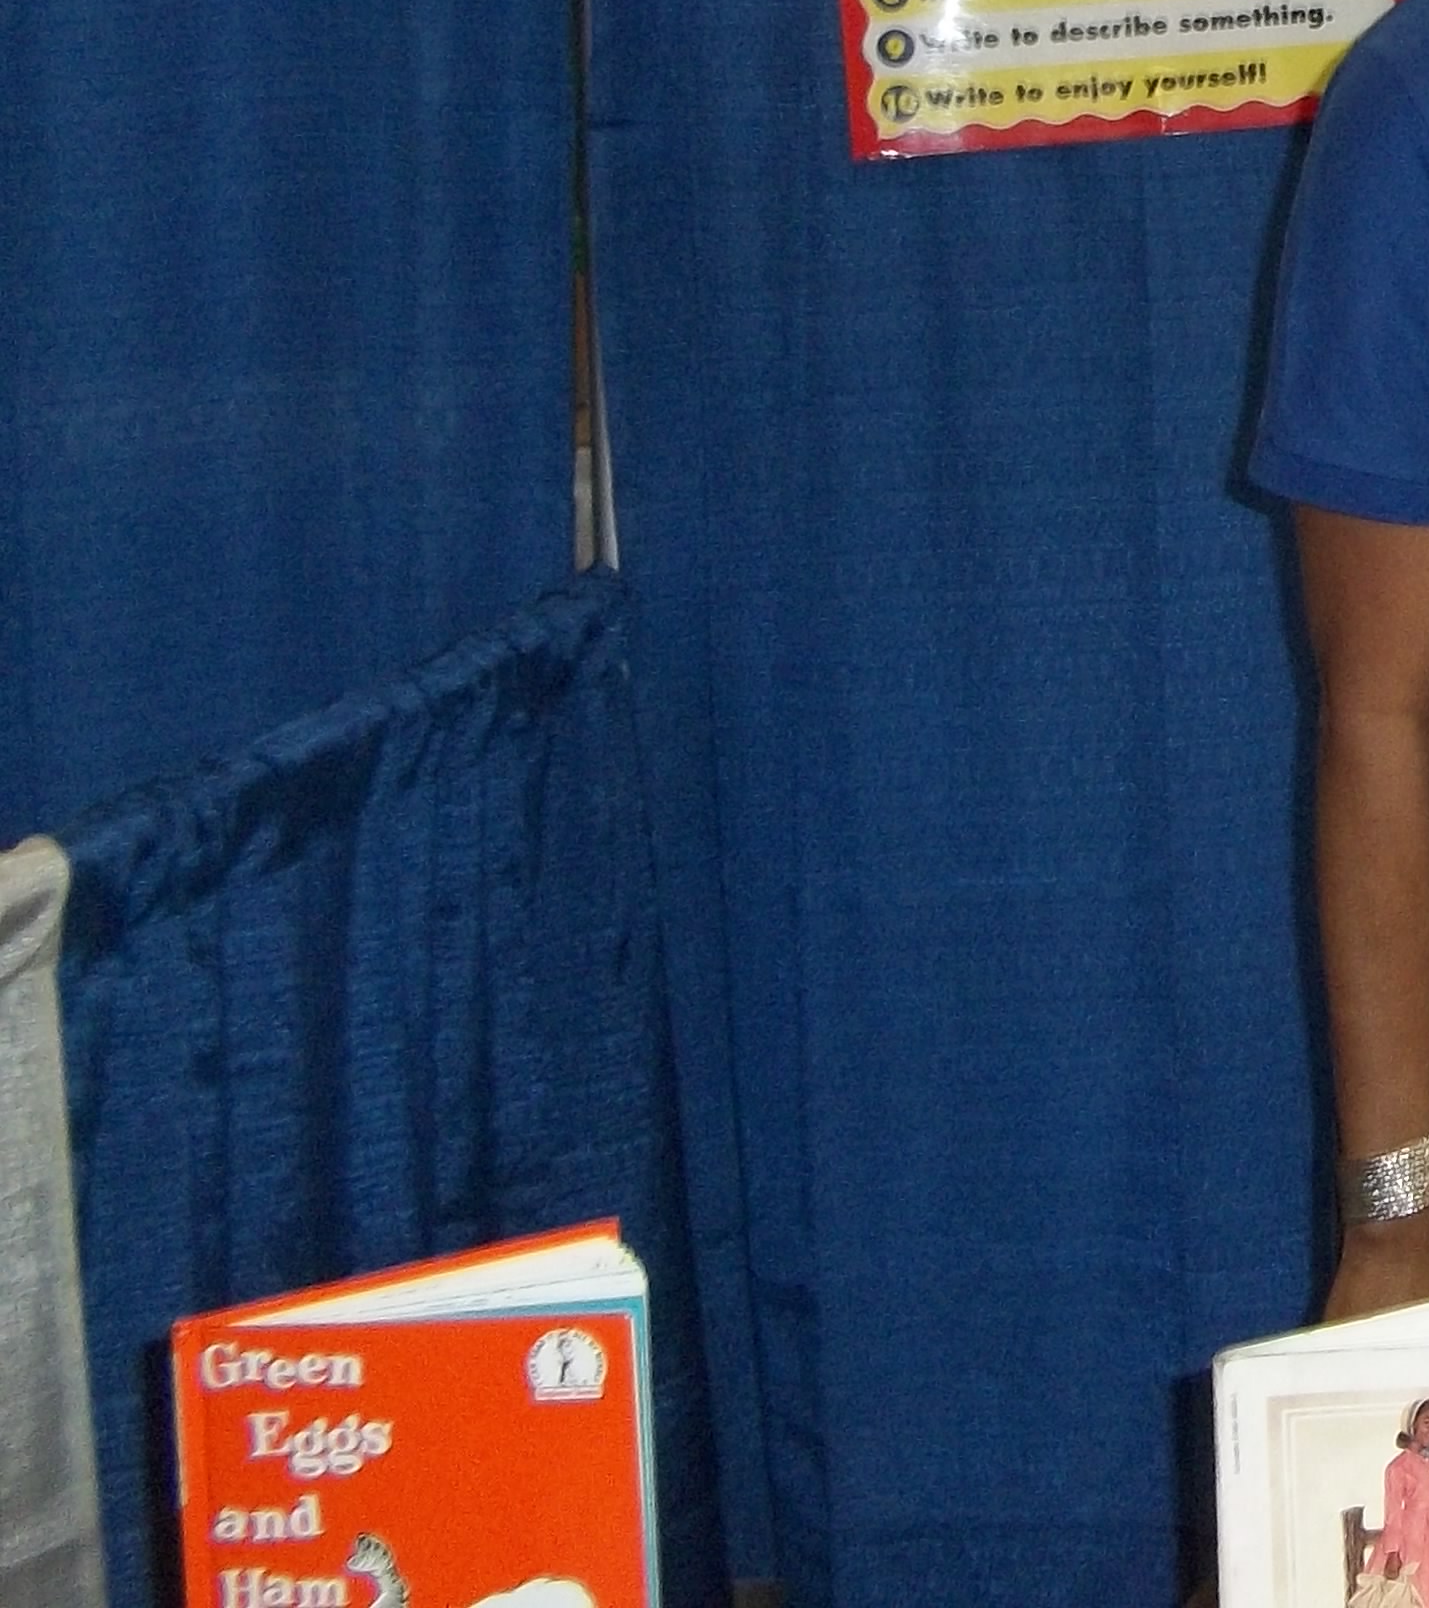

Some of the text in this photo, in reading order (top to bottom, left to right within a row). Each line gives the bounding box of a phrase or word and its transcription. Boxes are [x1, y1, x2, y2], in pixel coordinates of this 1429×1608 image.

[1011, 29, 1039, 44] to
[1051, 17, 1168, 41] describe
[1179, 5, 1333, 33] something.
[927, 63, 1266, 106] Write to enjoy yourself!
[200, 1341, 363, 1390] Green
[248, 1411, 394, 1478] Eggs
[212, 1493, 324, 1543] and
[220, 1569, 348, 1608] Ham
